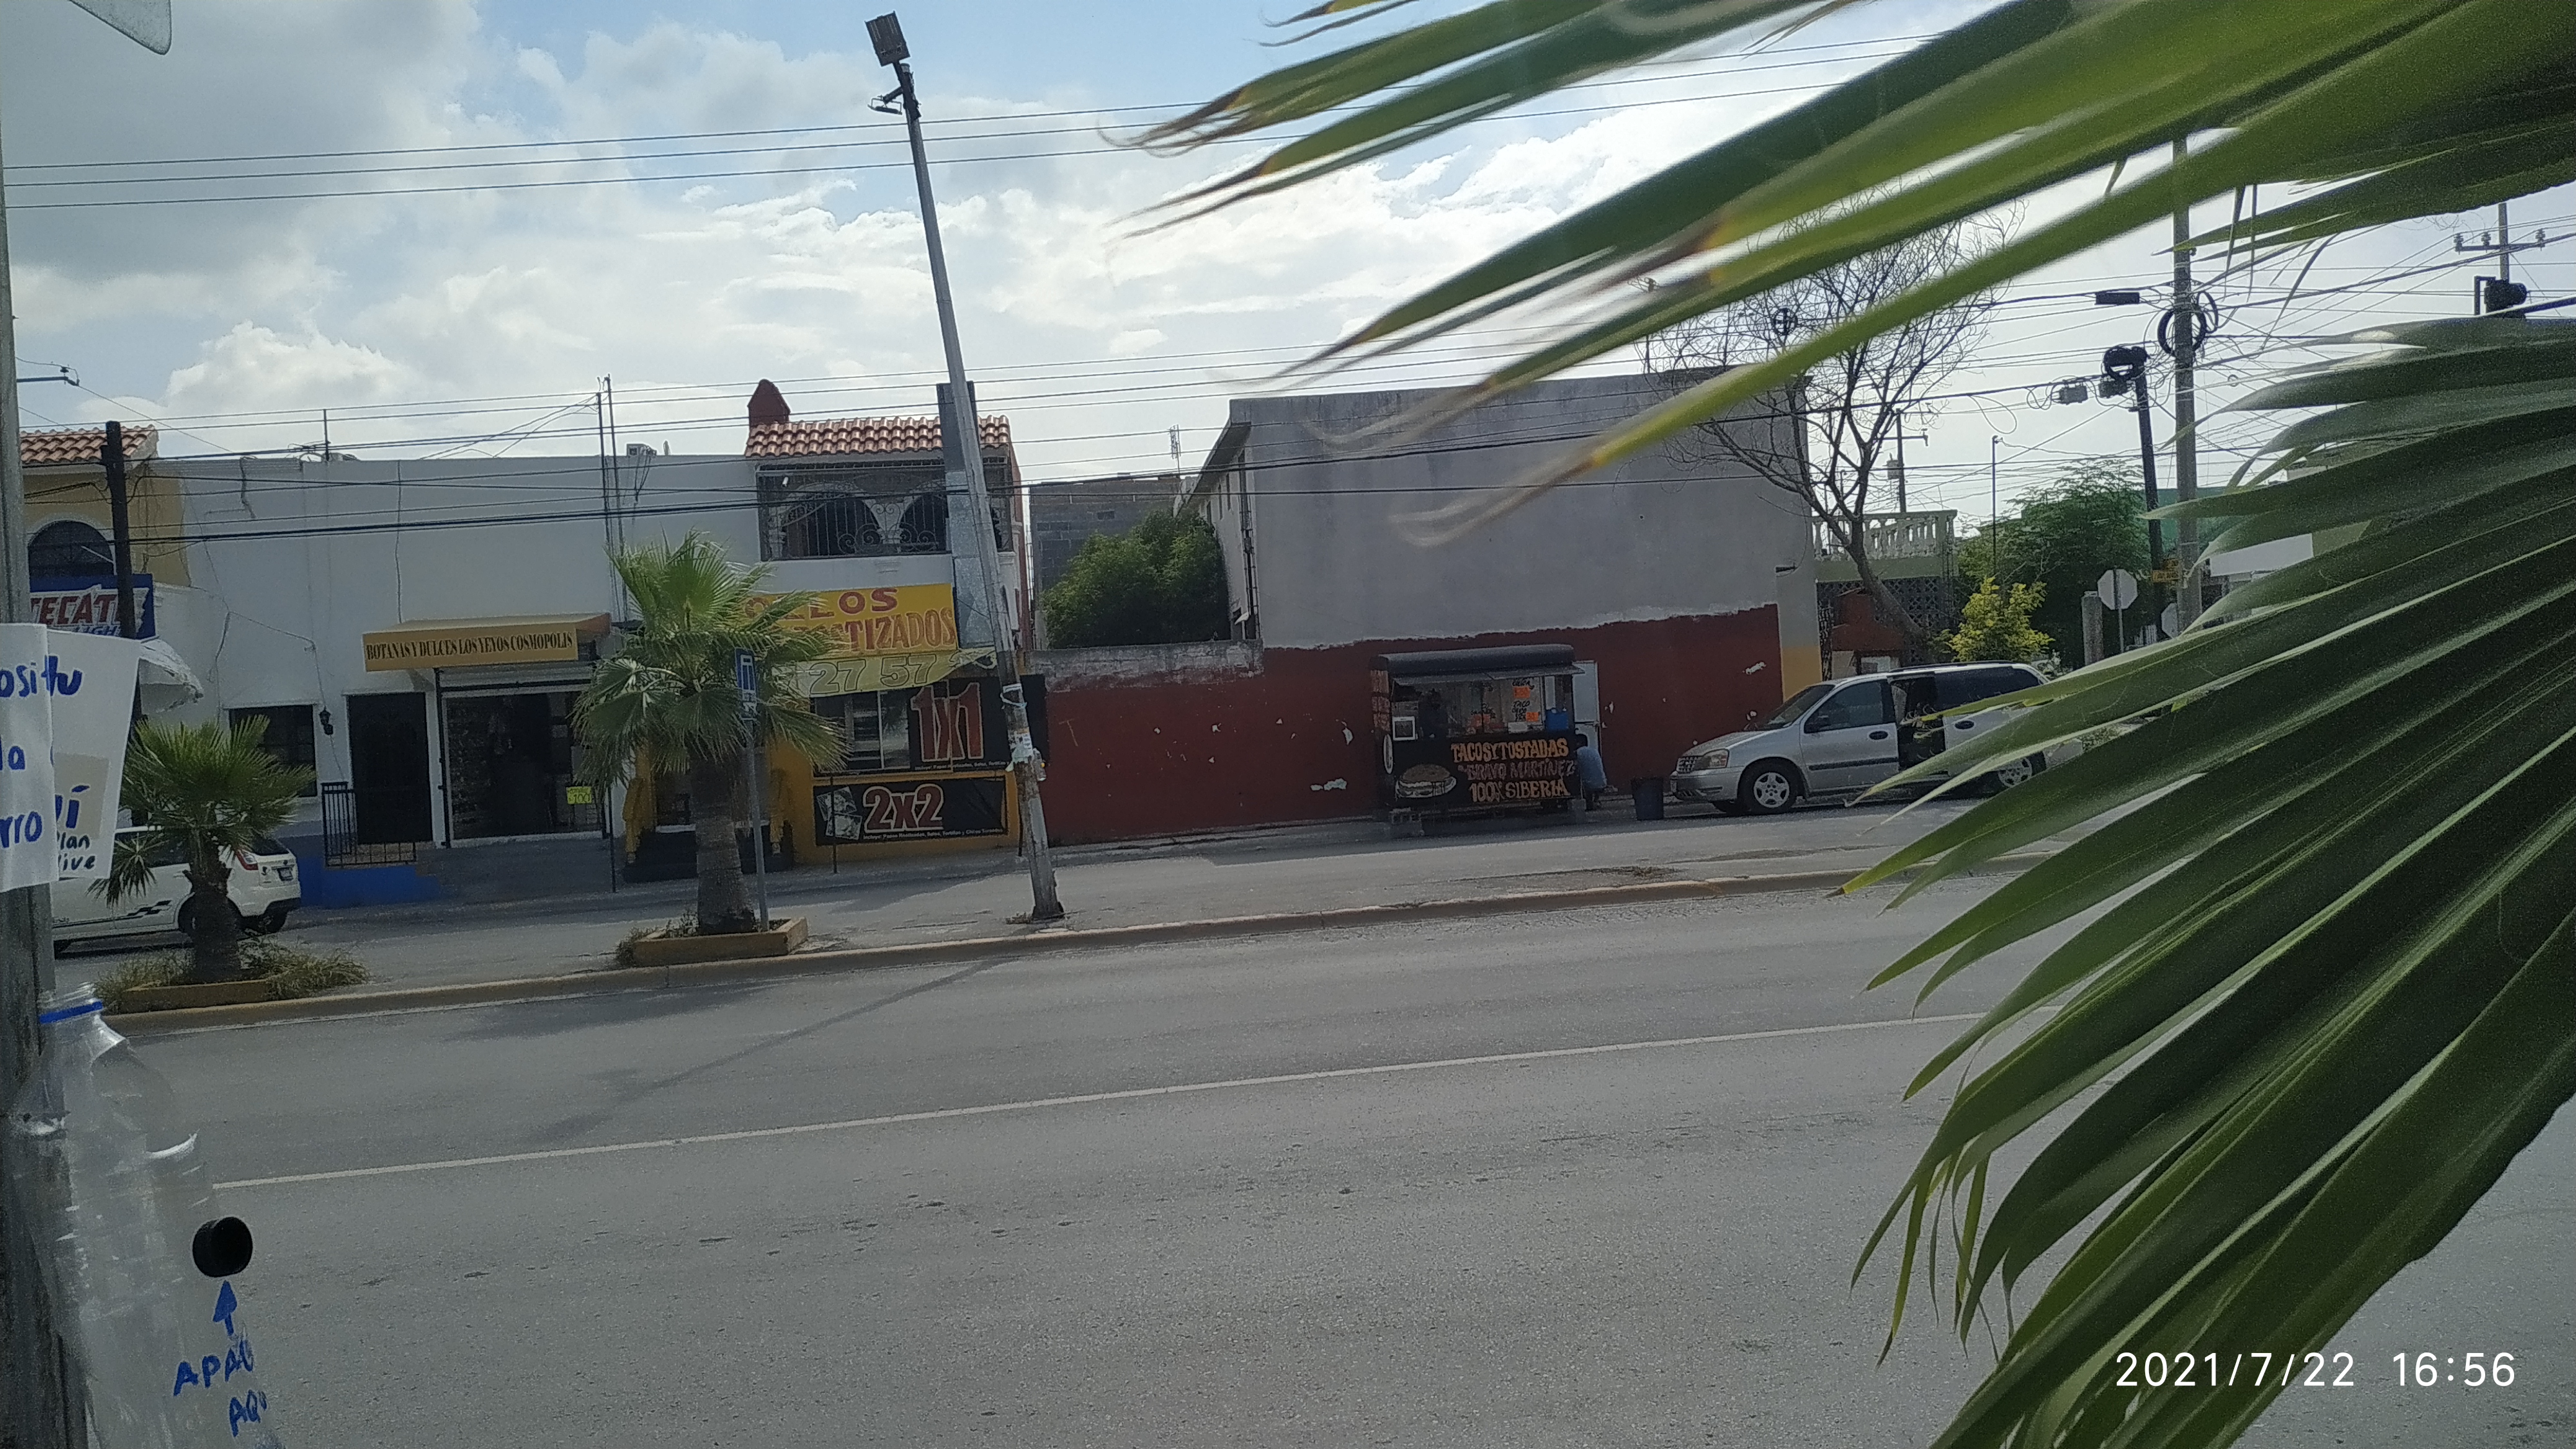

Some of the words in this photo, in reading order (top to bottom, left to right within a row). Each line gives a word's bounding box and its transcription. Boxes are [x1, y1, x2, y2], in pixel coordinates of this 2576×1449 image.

[30, 591, 120, 625] TECAT
[366, 641, 410, 660] BOTANAS
[411, 641, 417, 657] Y
[419, 639, 457, 657] DULCES
[459, 638, 477, 654] LOS
[510, 632, 573, 651] COSMOPOLIS
[808, 659, 867, 695] 27
[880, 653, 937, 688] 57
[863, 783, 944, 834] 2x2
